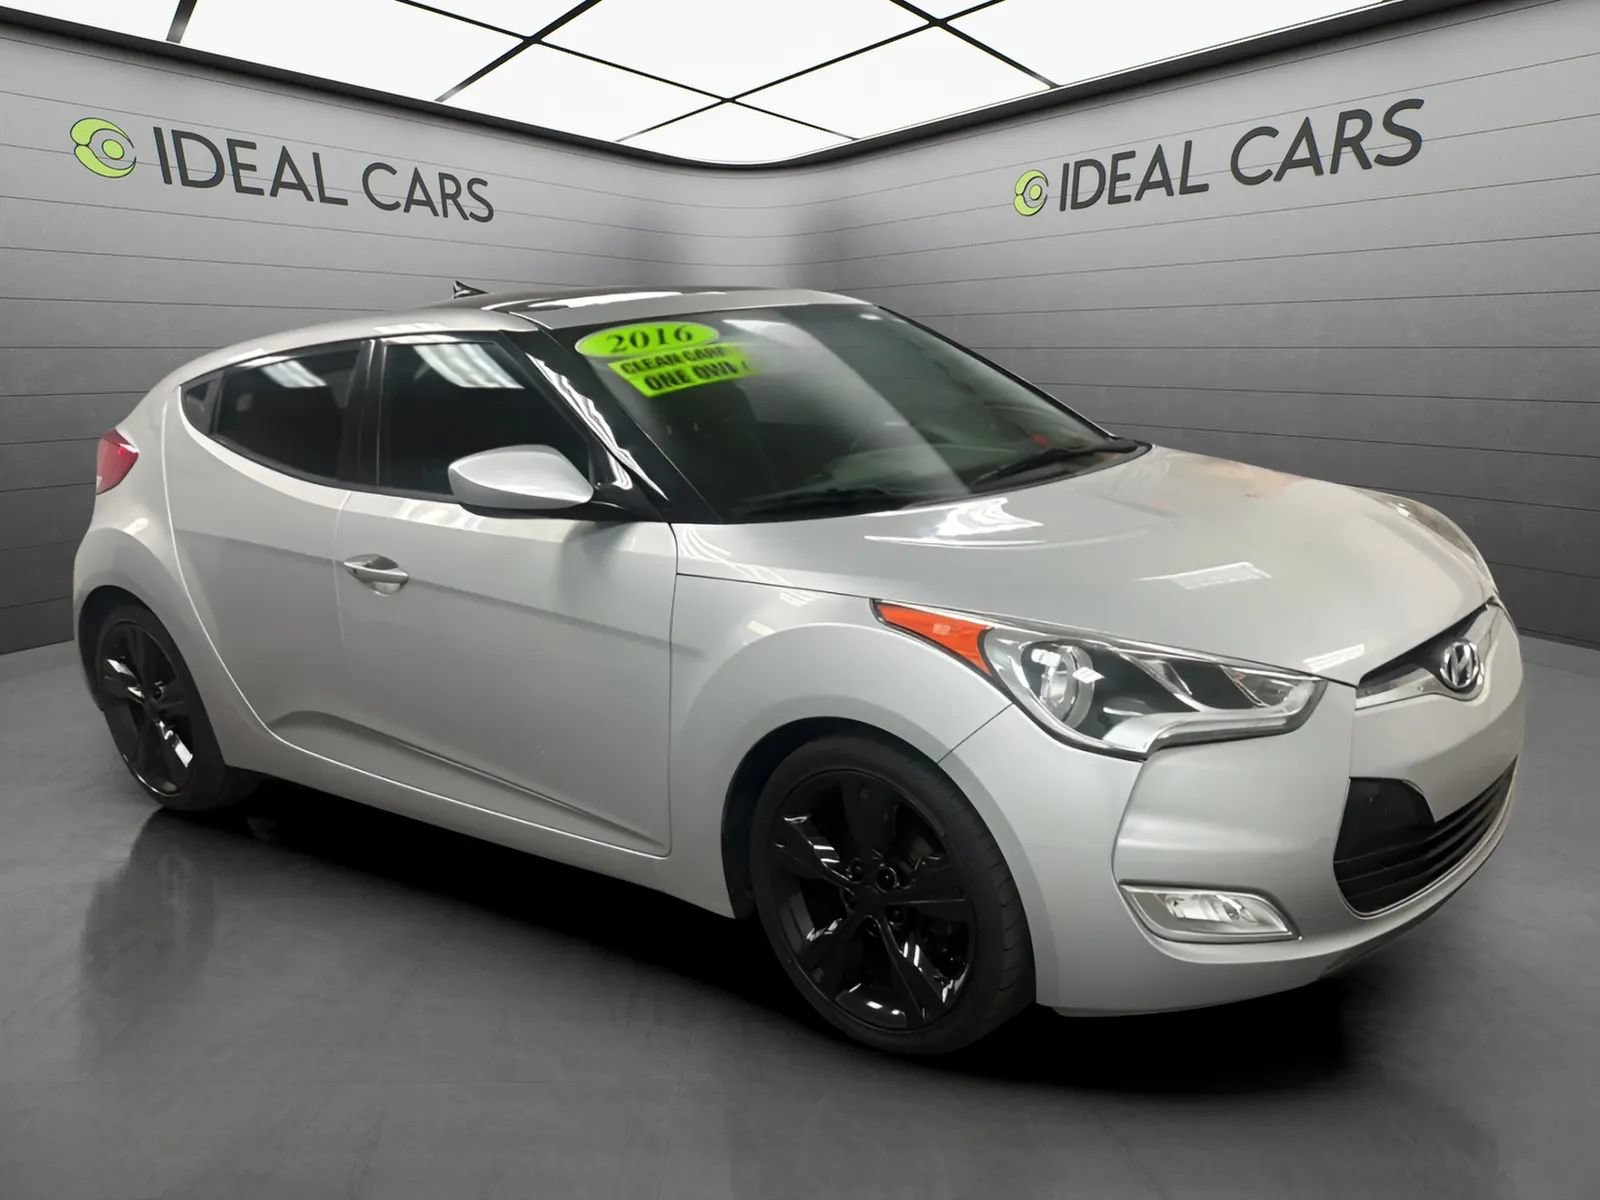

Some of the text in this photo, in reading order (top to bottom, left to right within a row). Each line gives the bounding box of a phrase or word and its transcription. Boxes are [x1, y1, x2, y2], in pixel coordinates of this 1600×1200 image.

[1059, 98, 1425, 212] IDEAL CARS
[152, 126, 494, 223] IDEAL CARS
[606, 325, 693, 353] 2016
[620, 352, 684, 375] CLEAN
[644, 369, 691, 391] ONE
